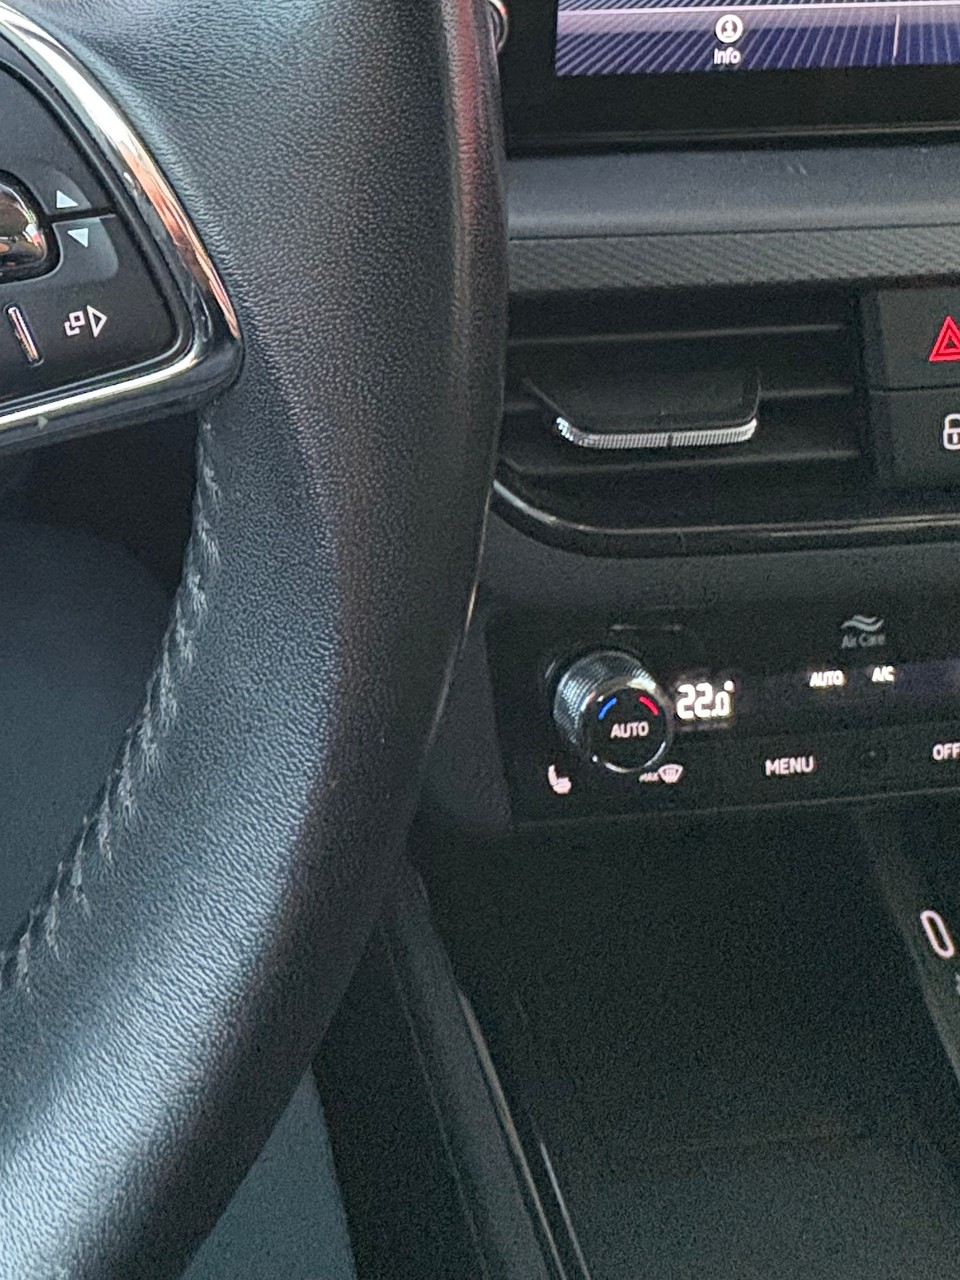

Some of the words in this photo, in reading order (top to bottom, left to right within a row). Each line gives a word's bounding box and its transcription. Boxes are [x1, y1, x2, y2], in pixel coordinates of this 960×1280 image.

[713, 47, 741, 66] Info
[809, 670, 845, 687] AUTO
[610, 721, 649, 739] AUTO
[932, 742, 960, 761] OFF
[765, 756, 816, 776] MENU
